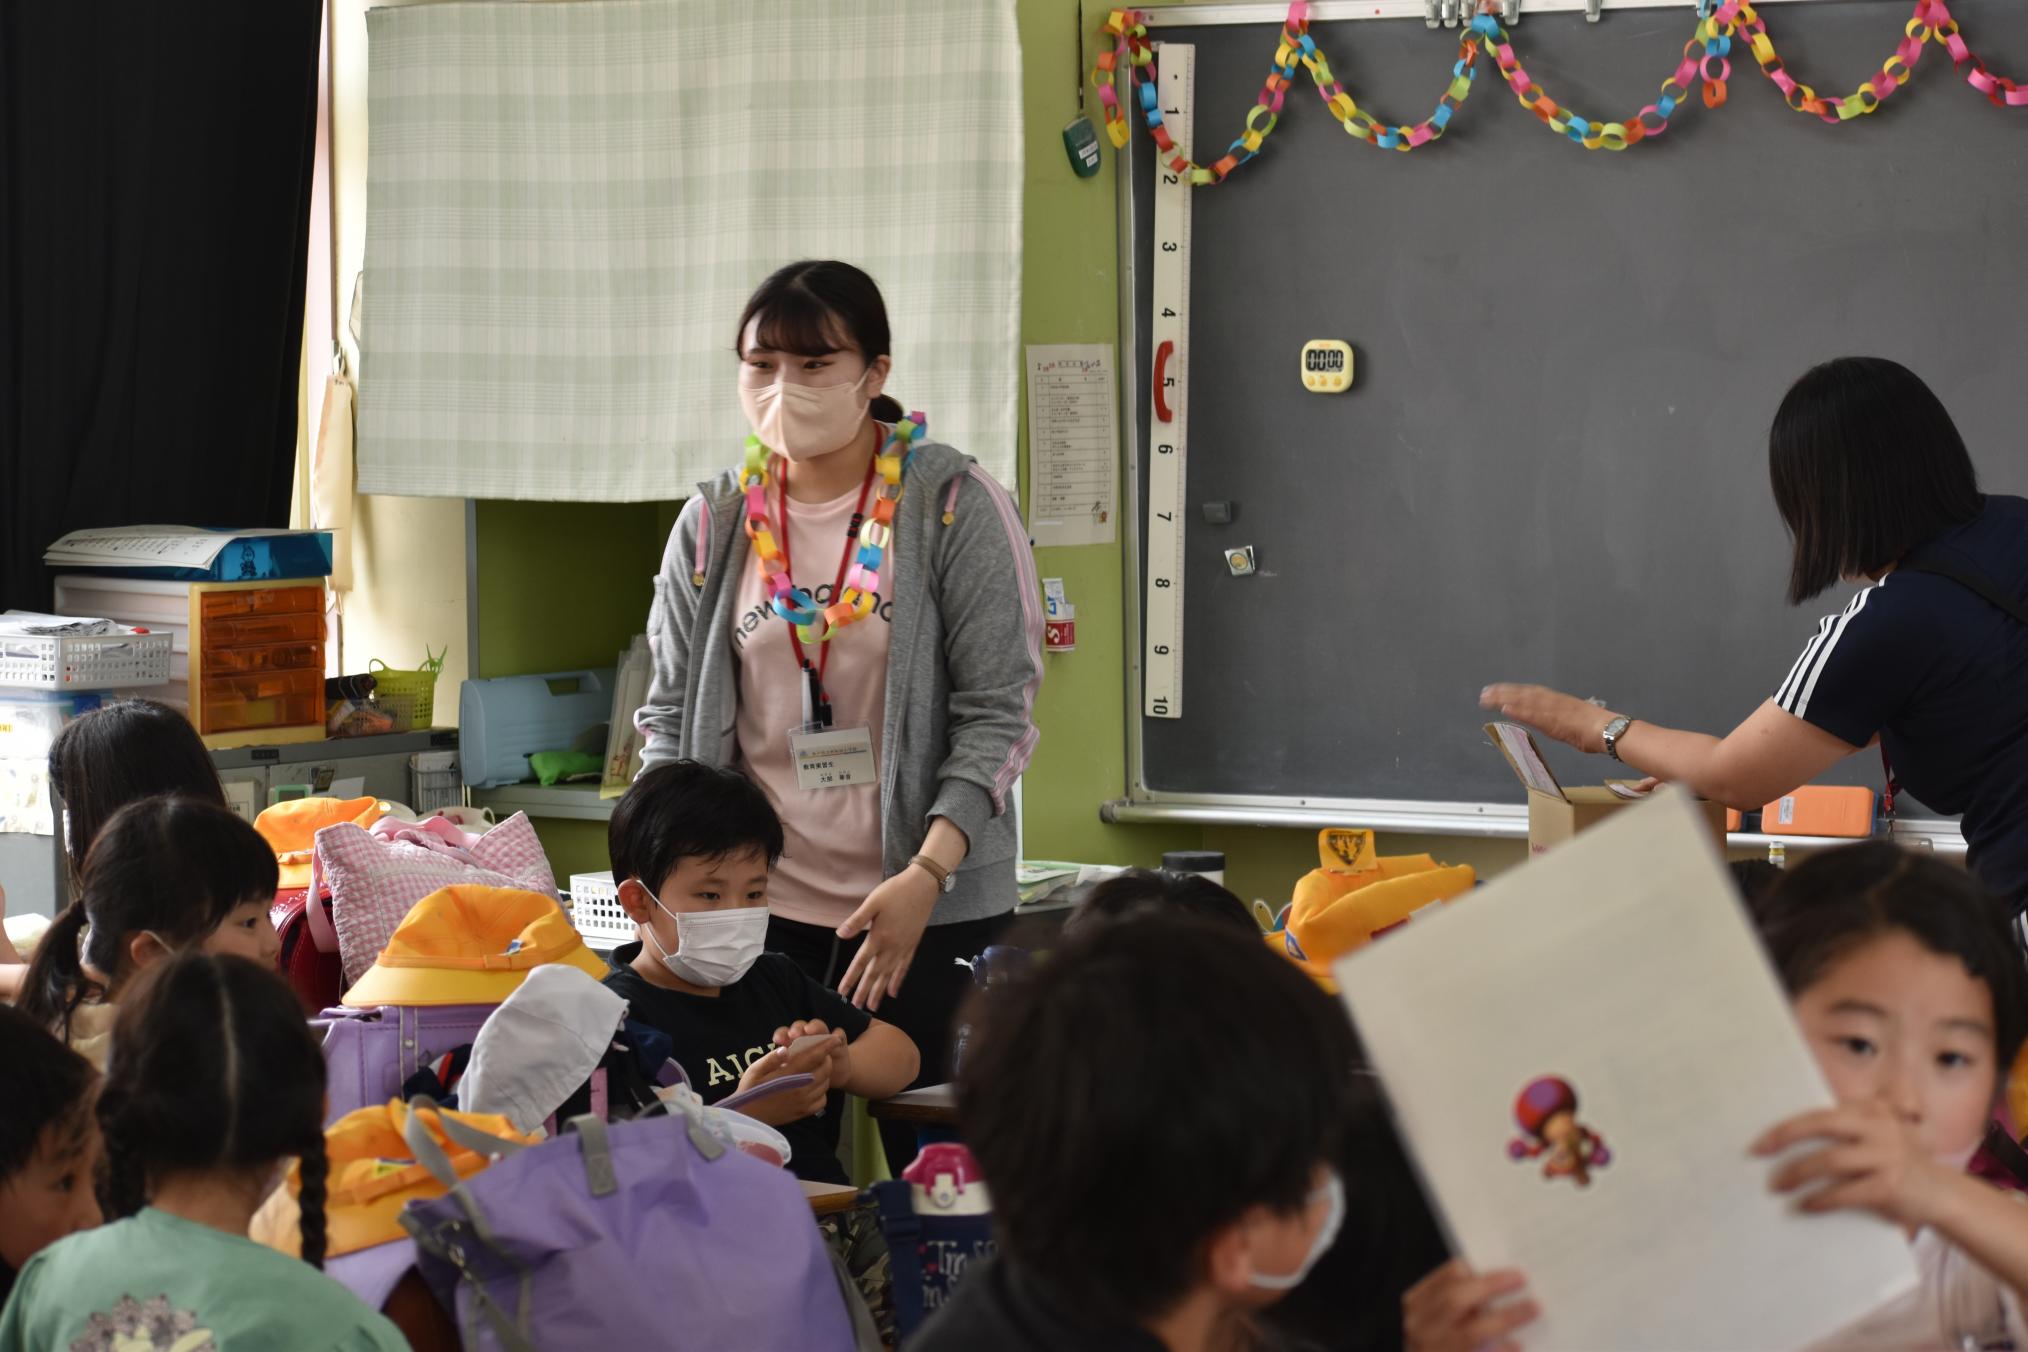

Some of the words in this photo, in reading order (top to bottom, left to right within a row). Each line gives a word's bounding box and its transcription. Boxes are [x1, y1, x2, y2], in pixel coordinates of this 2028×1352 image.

[1163, 174, 1178, 185] 2
[1162, 241, 1177, 252] 3
[1161, 307, 1176, 318] 4
[1163, 377, 1175, 387] 5
[1158, 444, 1173, 454] 6
[1157, 512, 1172, 522] 7
[1155, 578, 1170, 588] 8
[1154, 645, 1169, 655] 9
[1153, 696, 1168, 715] 10
